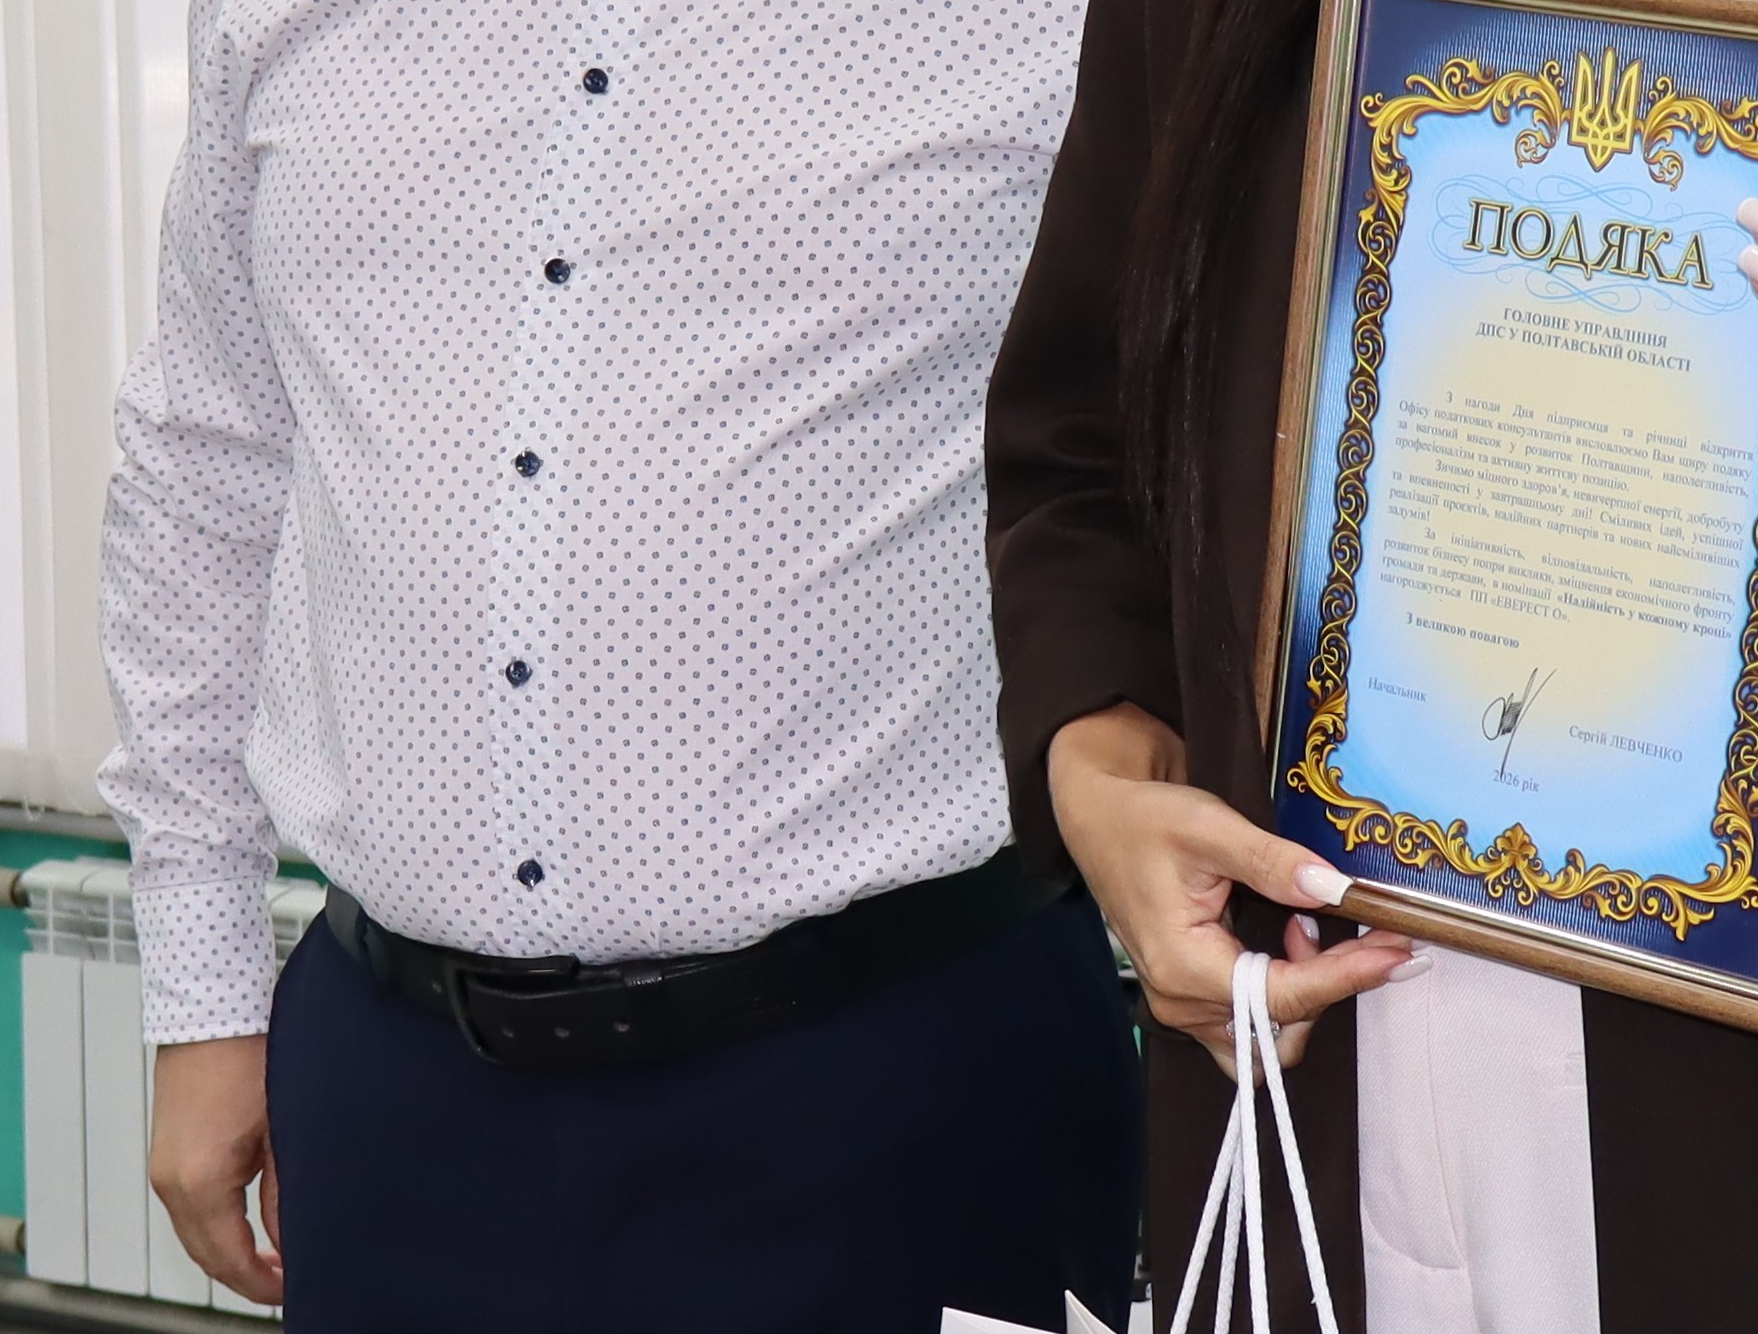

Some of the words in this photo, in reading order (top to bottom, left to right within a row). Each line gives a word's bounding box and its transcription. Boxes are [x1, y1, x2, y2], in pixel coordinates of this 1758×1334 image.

[1463, 197, 1714, 291] ПОДЯКА
[1475, 322, 1505, 338] ДПС
[1508, 327, 1519, 341] У
[1522, 330, 1623, 360] ПОЛТАВСЬКІЙ
[1626, 348, 1691, 372] ОБЛАСТІ
[1503, 308, 1570, 331] ГОЛОВНЕ
[1573, 320, 1667, 348] УПРАВЛІННЯ
[1396, 420, 1407, 428] за
[1416, 424, 1458, 439] вагомий
[1466, 434, 1502, 447] внесок
[1509, 442, 1516, 454] у
[1524, 445, 1573, 461] розвиток
[1581, 453, 1652, 479] Полтавщини,
[1662, 472, 1748, 499] наполегливість,
[1398, 400, 1430, 419] Офісу
[1434, 410, 1493, 428] податкових
[1497, 422, 1571, 443] консультантів
[1575, 437, 1648, 458] висловлюємо
[1652, 449, 1674, 464] Вам
[1678, 458, 1708, 474] щиру
[1712, 464, 1751, 483] подяку
[1446, 391, 1453, 402] З
[1464, 398, 1500, 412] нагоди
[1512, 404, 1533, 418] Дня
[1546, 412, 1608, 434] підприємця
[1622, 429, 1633, 438] та
[1645, 431, 1687, 449] річниці
[1700, 441, 1753, 461] відкриття
[1395, 438, 1474, 460] професіоналізм
[1478, 454, 1489, 463] та
[1491, 457, 1532, 475] активну
[1535, 465, 1579, 484] життєву
[1582, 474, 1629, 491] позицію.
[1435, 460, 1474, 477] Зичимо
[1477, 469, 1518, 486] міцного
[1573, 491, 1641, 511] невичерпної
[1643, 505, 1682, 522] енергії,
[1686, 512, 1745, 536] добробуту
[1387, 505, 1430, 521] задумів!
[1389, 488, 1439, 505] реалізації
[1494, 510, 1542, 526] надійних
[1546, 521, 1599, 540] партнерів
[1602, 532, 1614, 542] та
[1619, 536, 1652, 550] нових
[1657, 543, 1740, 568] найсміливіших
[1392, 471, 1402, 480] та
[1409, 475, 1470, 494] впевненості
[1476, 489, 1483, 500] у
[1490, 491, 1564, 517] завтрашньому
[1571, 506, 1592, 519] дні!
[1600, 510, 1652, 531] Сміливих
[1659, 522, 1684, 540] ідей,
[1691, 532, 1743, 550] успішної
[1380, 572, 1461, 597] нагороджується
[1470, 589, 1487, 603] ПП
[1382, 554, 1424, 571] громади
[1427, 564, 1438, 573] та
[1439, 567, 1486, 586] держави,
[1492, 579, 1498, 587] в
[1501, 581, 1551, 598] номінації
[1556, 591, 1625, 615] «Надійність
[1627, 609, 1635, 621] у
[1638, 611, 1689, 633] кожному
[1383, 537, 1429, 554] розвиток
[1432, 545, 1469, 566] бізнесу
[1473, 557, 1504, 573] попри
[1508, 565, 1554, 584] виклики,
[1558, 575, 1612, 595] зміцнення
[1616, 588, 1690, 612] економічного
[1692, 602, 1734, 625] фронту
[1424, 527, 1436, 539] За
[1451, 533, 1525, 561] ініціативність,
[1541, 554, 1632, 584] відповідальність,
[1649, 579, 1735, 607] наполегливість,
[1406, 612, 1413, 625] З
[1415, 618, 1466, 637] великою
[1469, 630, 1519, 649] повагою
[1367, 676, 1427, 702] Начальник
[1568, 724, 1607, 745] Сергій
[1610, 734, 1683, 763] ЛЕВЧЕНКО
[1521, 778, 1539, 793] рік
